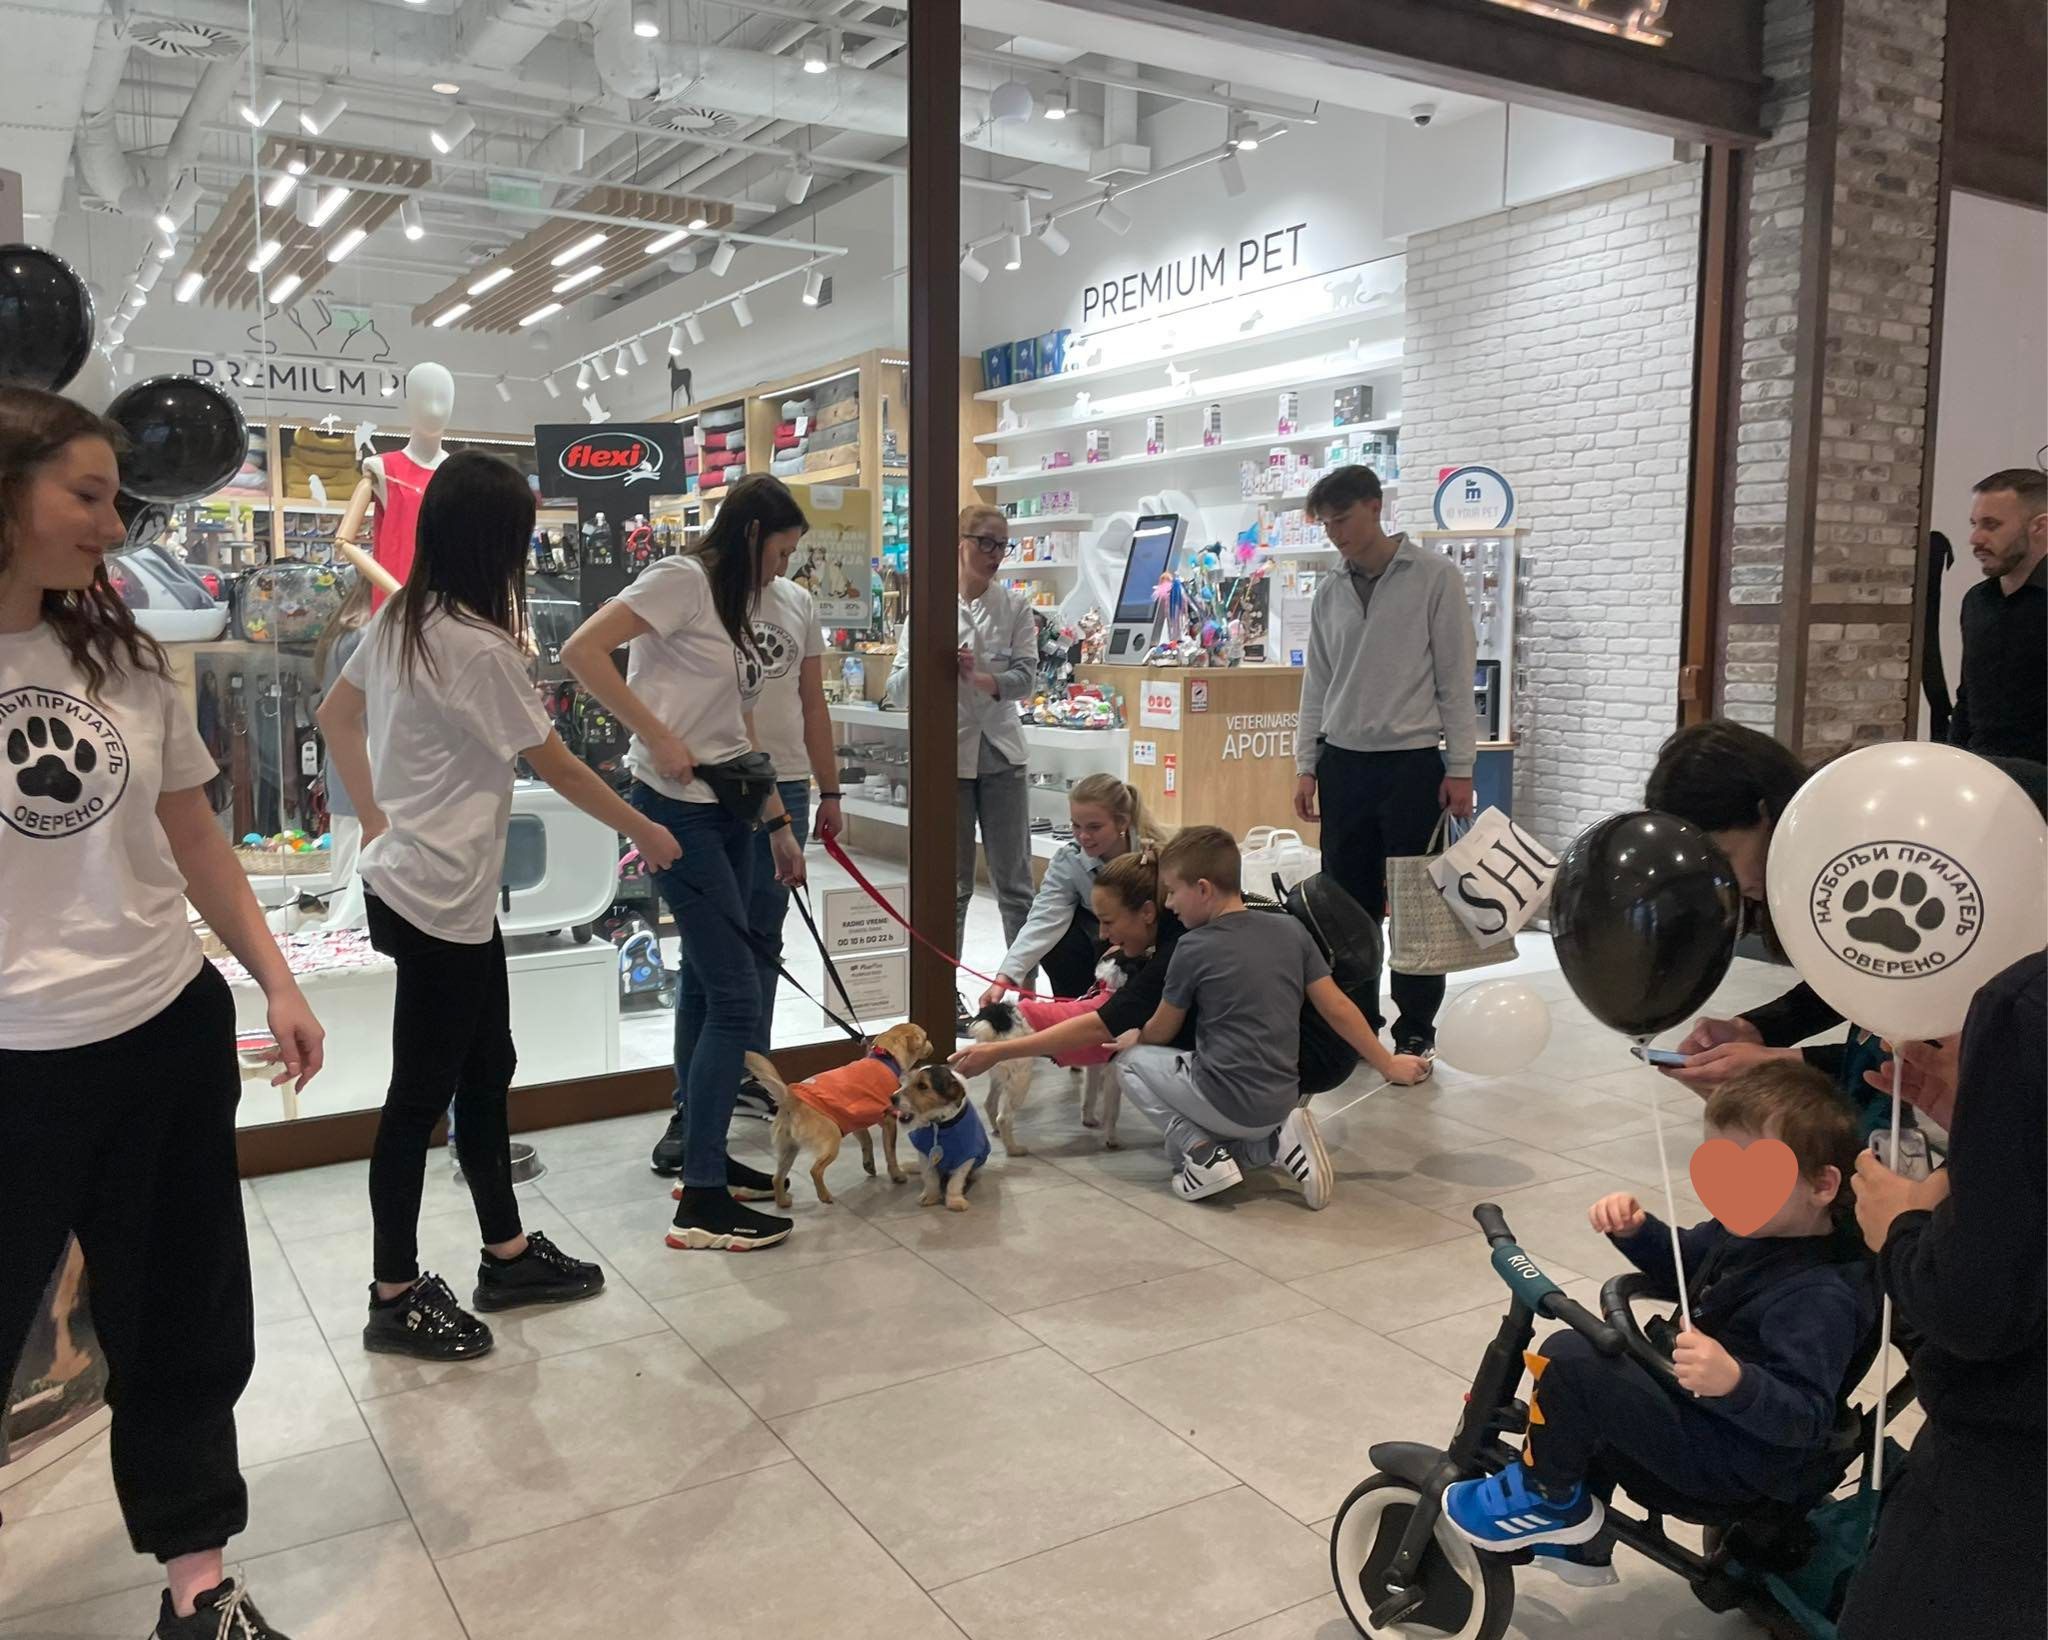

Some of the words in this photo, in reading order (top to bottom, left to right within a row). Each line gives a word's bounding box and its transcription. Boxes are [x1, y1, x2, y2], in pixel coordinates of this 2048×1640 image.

[1082, 247, 1225, 323] PREMIUM
[1239, 223, 1308, 282] PET
[566, 443, 642, 469] flexi
[36, 693, 123, 775] ПРИЈАТЕЉ
[14, 796, 104, 831] ОВЕРЕНО
[1816, 846, 1889, 924] НАЈБОЉИ
[1898, 847, 1977, 936] ПРИЈАТЕЉ
[1841, 946, 1946, 974] ОВЕРЕНО
[1507, 1254, 1541, 1279] RITO
